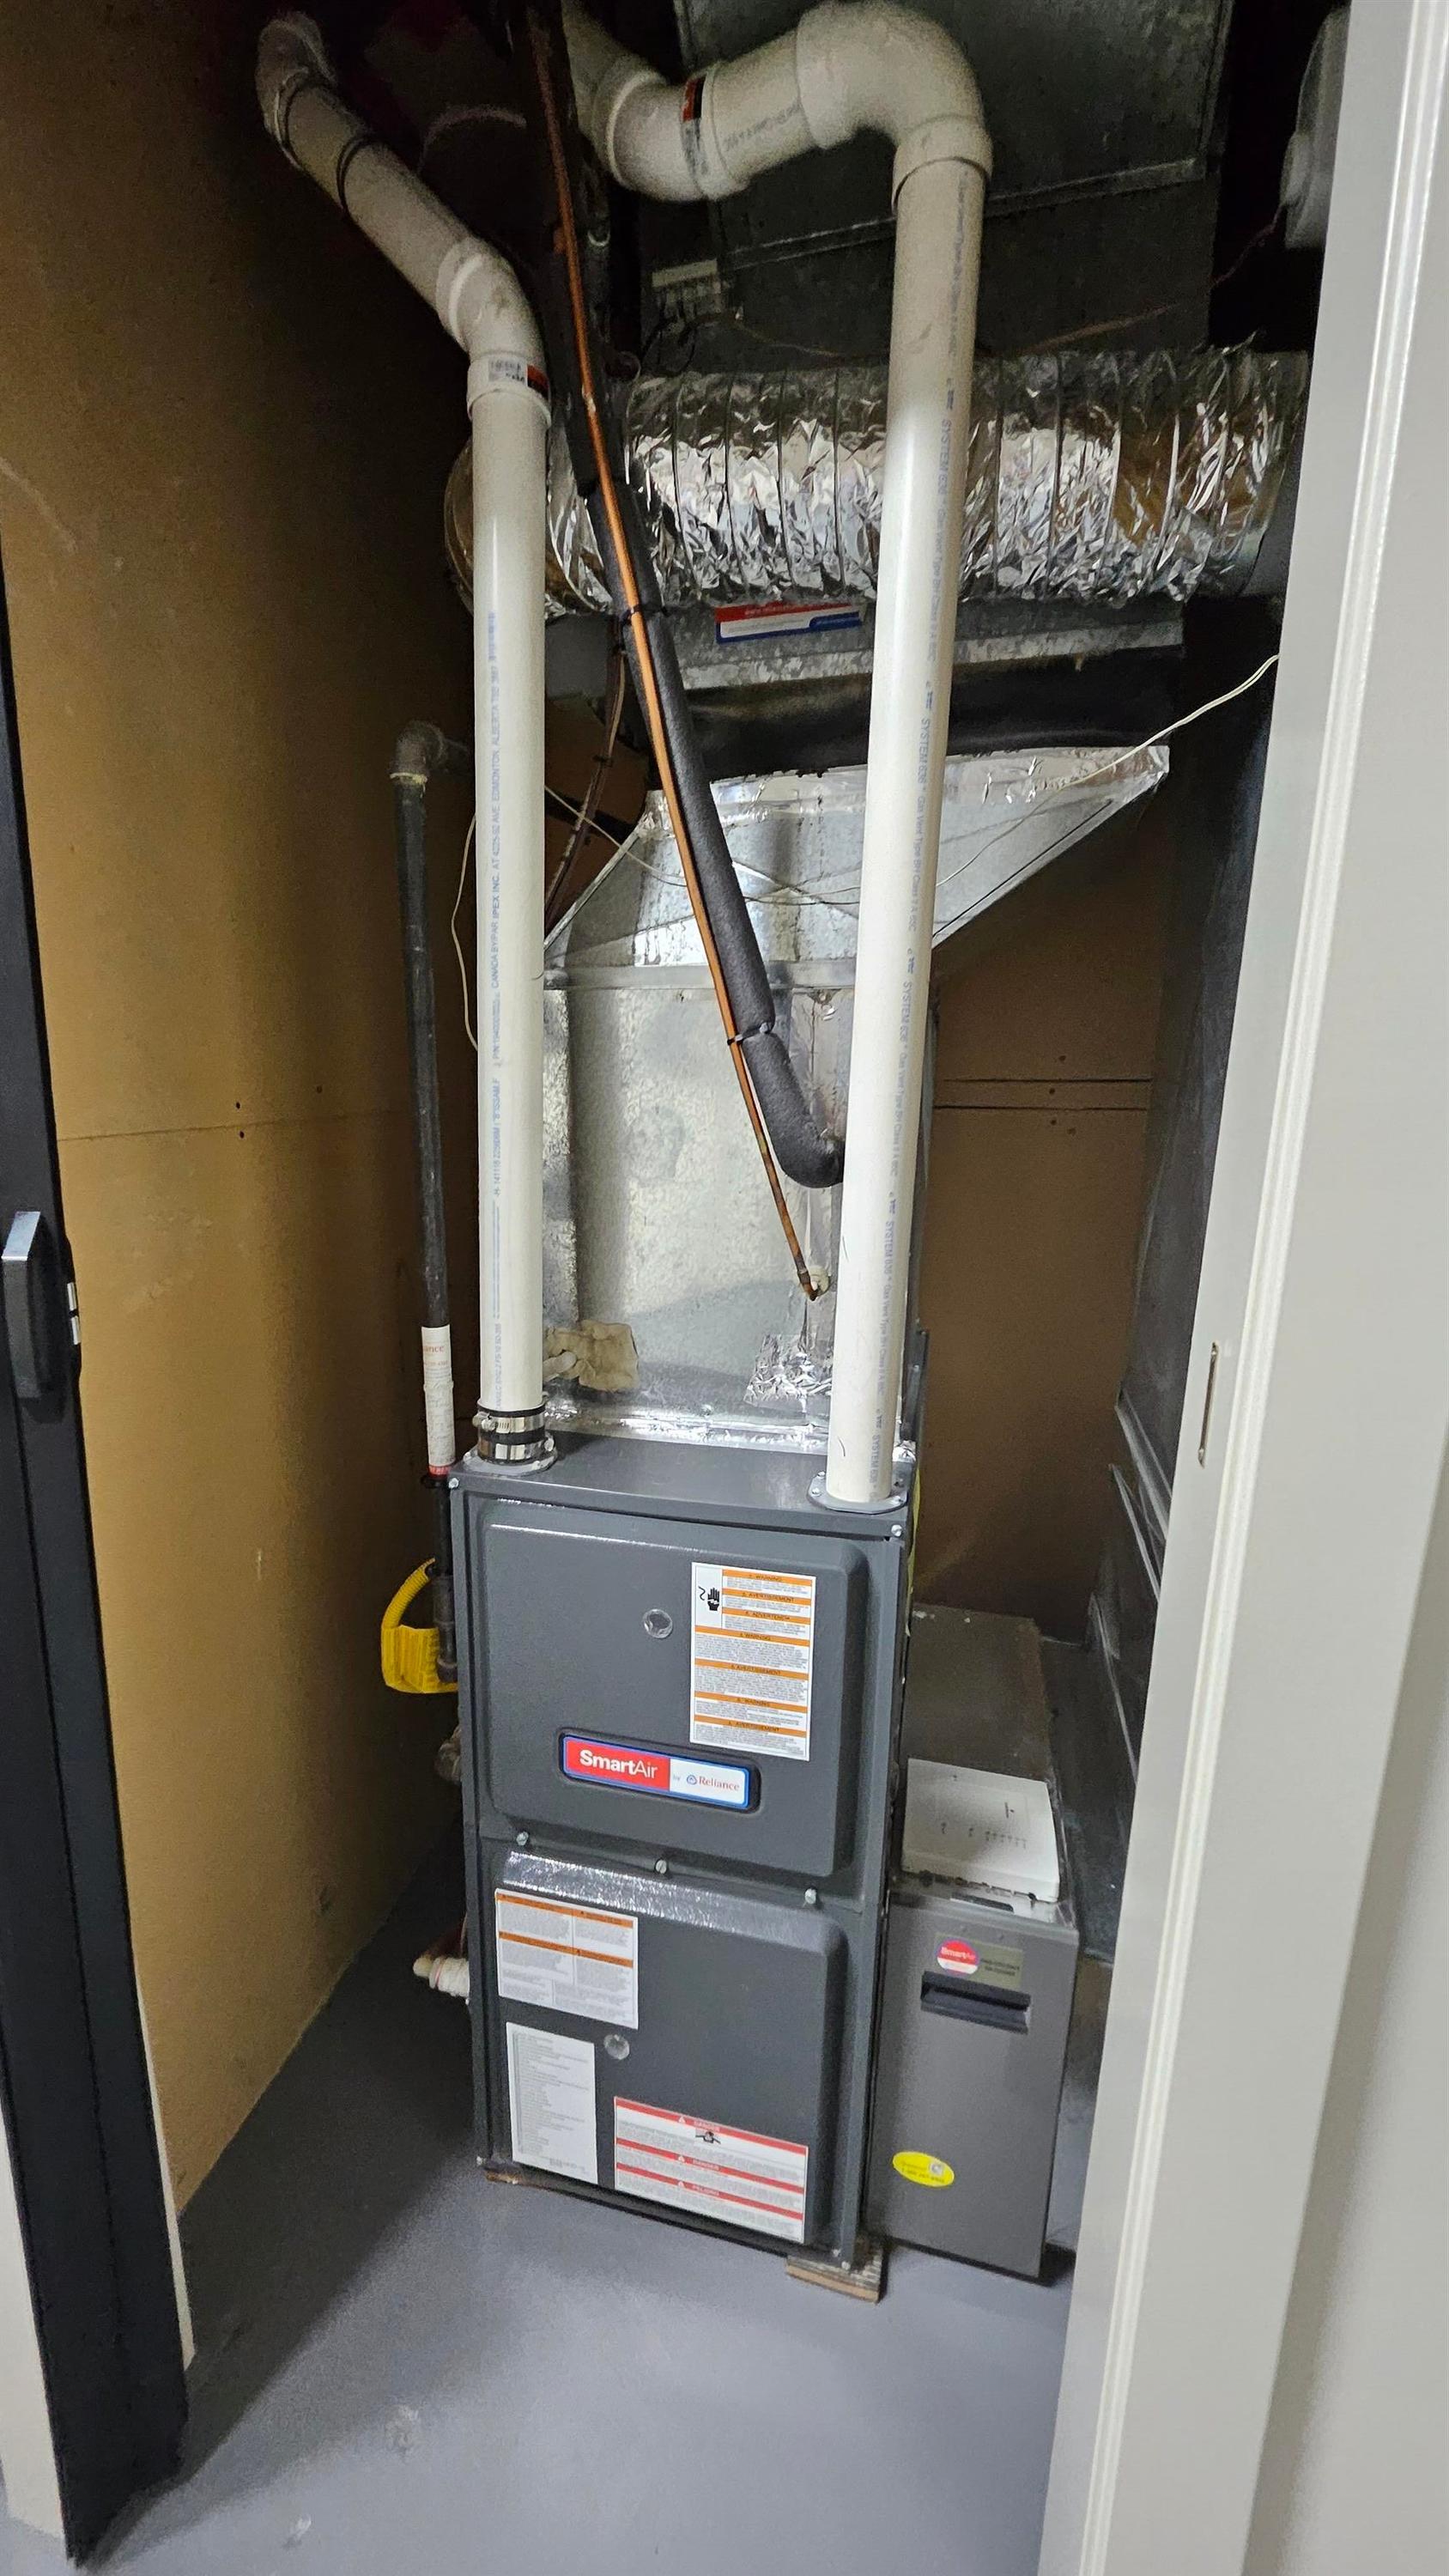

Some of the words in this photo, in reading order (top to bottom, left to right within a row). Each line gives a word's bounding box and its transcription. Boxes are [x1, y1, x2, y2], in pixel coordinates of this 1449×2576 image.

[918, 718, 931, 762] SYSTEM
[900, 981, 912, 1023] SYSTEM
[882, 1220, 894, 1257] SYSTEM
[870, 1433, 881, 1468] SYSTEM
[579, 1749, 658, 1780] SmartAir
[698, 1775, 740, 1792] Reliance
